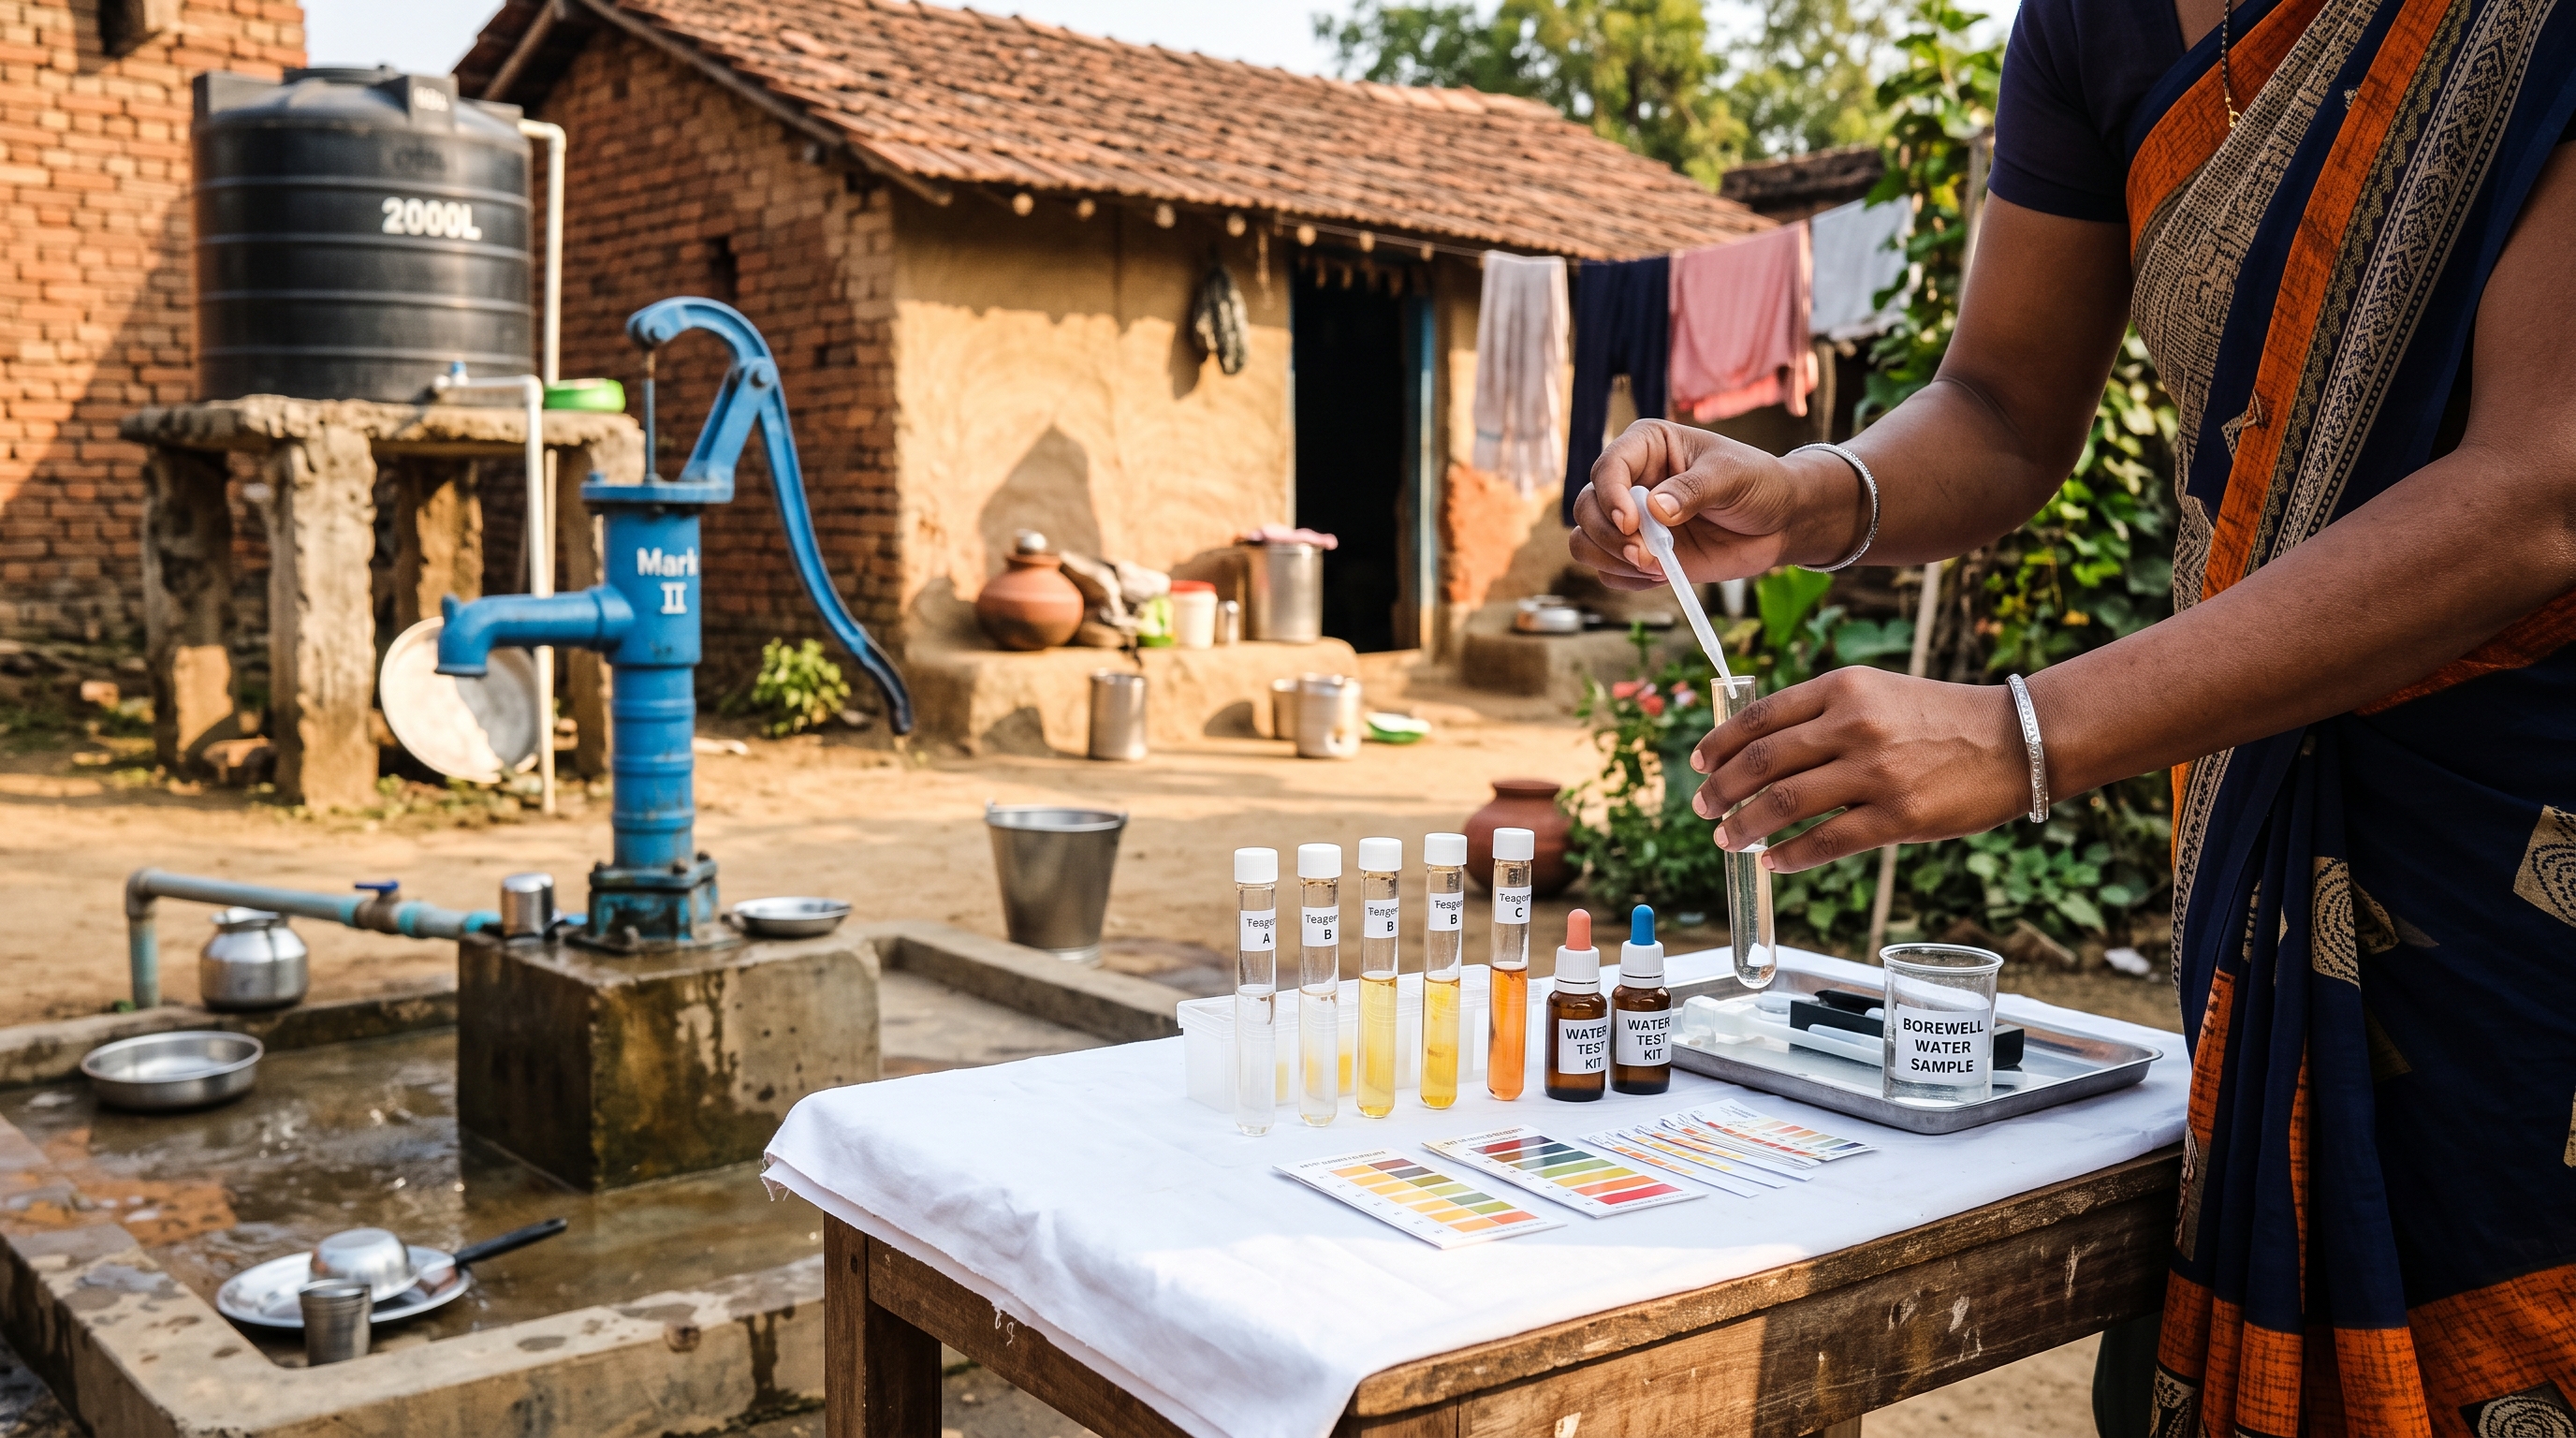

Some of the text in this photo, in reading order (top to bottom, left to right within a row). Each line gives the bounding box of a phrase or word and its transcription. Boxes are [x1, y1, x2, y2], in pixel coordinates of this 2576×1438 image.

[382, 197, 482, 242] 2000L
[660, 581, 687, 615] II
[1515, 907, 1523, 917] C
[1450, 914, 1457, 924] B
[1387, 921, 1395, 932] B
[1263, 933, 1270, 944] A
[1325, 930, 1332, 940] B
[1628, 1017, 1670, 1031] WATER
[1903, 1018, 1983, 1034] BOREWELL
[1566, 1024, 1607, 1039] WATER
[1636, 1033, 1667, 1046] TEST
[1915, 1039, 1971, 1053] WATER
[1577, 1041, 1605, 1055] TEST
[1644, 1049, 1662, 1060] KIT
[1585, 1056, 1602, 1069] KIT
[1910, 1058, 1974, 1073] SAMPLE
